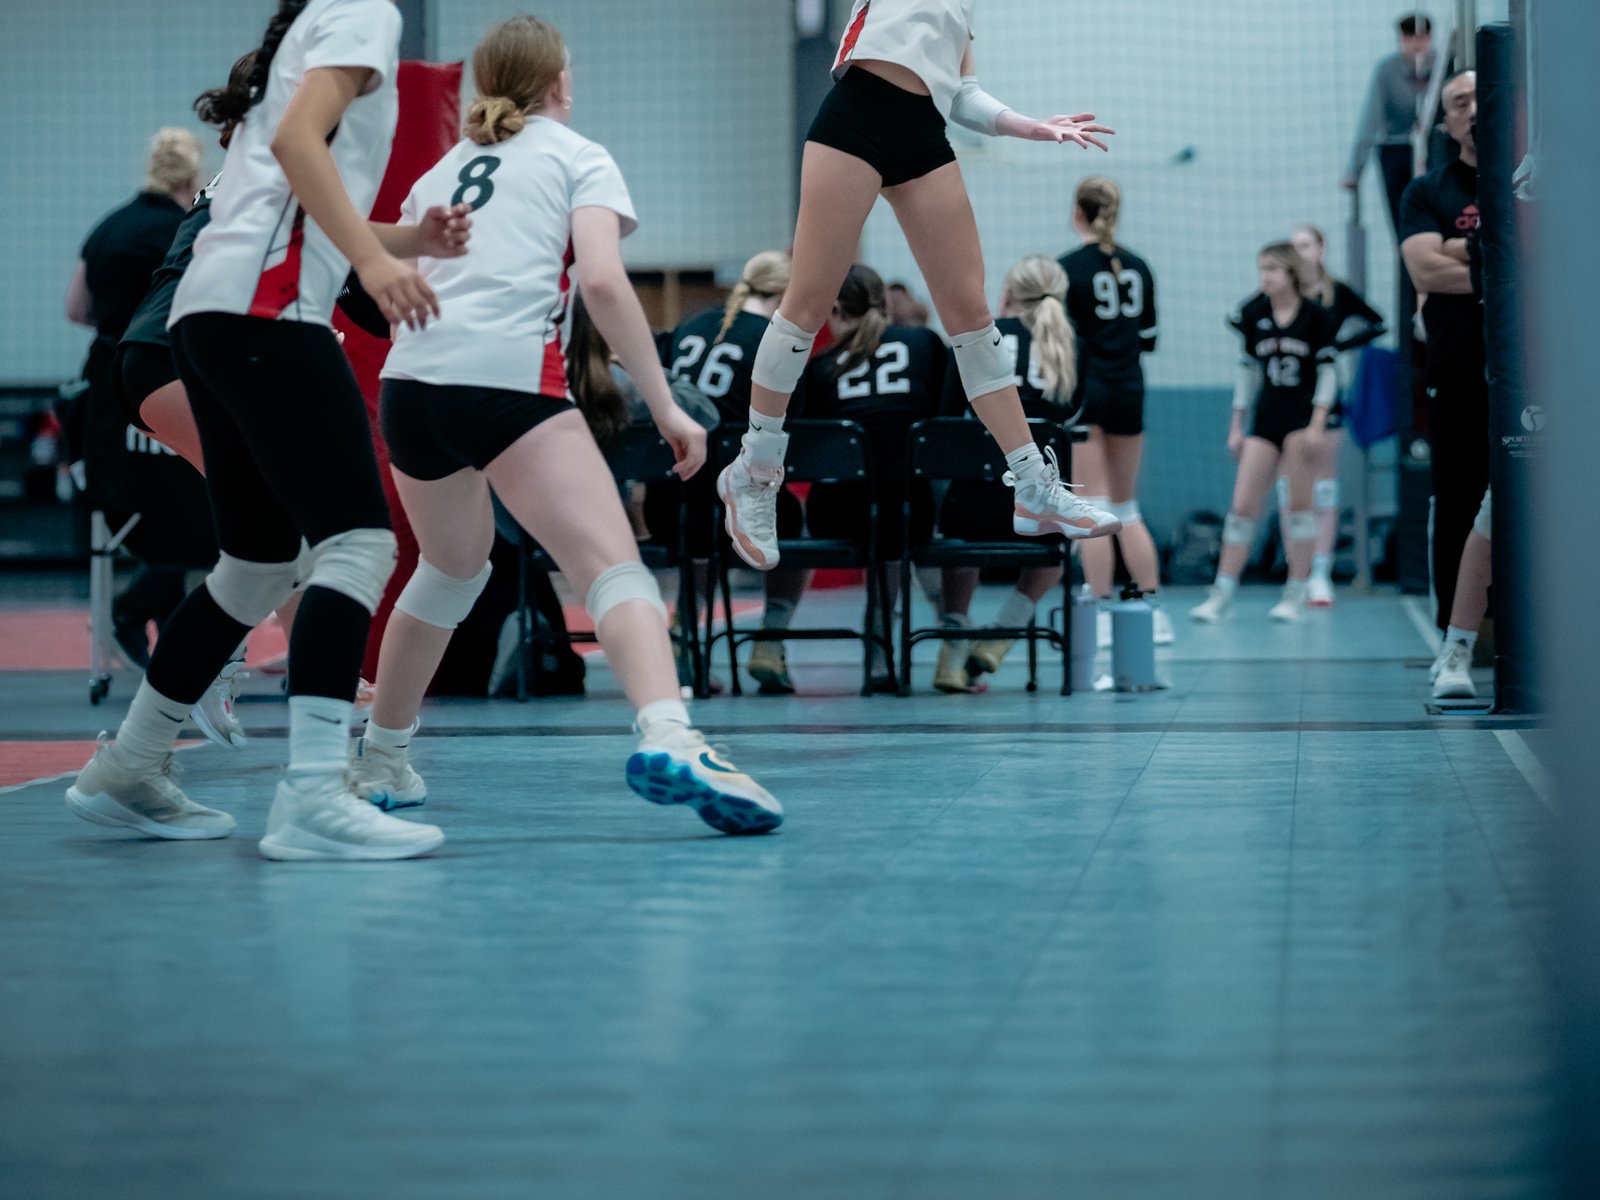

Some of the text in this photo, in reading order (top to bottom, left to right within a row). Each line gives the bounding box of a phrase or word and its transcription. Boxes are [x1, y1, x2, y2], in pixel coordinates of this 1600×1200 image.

[451, 155, 502, 214] 8
[1092, 268, 1144, 320] 93
[671, 334, 744, 398] 26
[836, 340, 911, 400] 22
